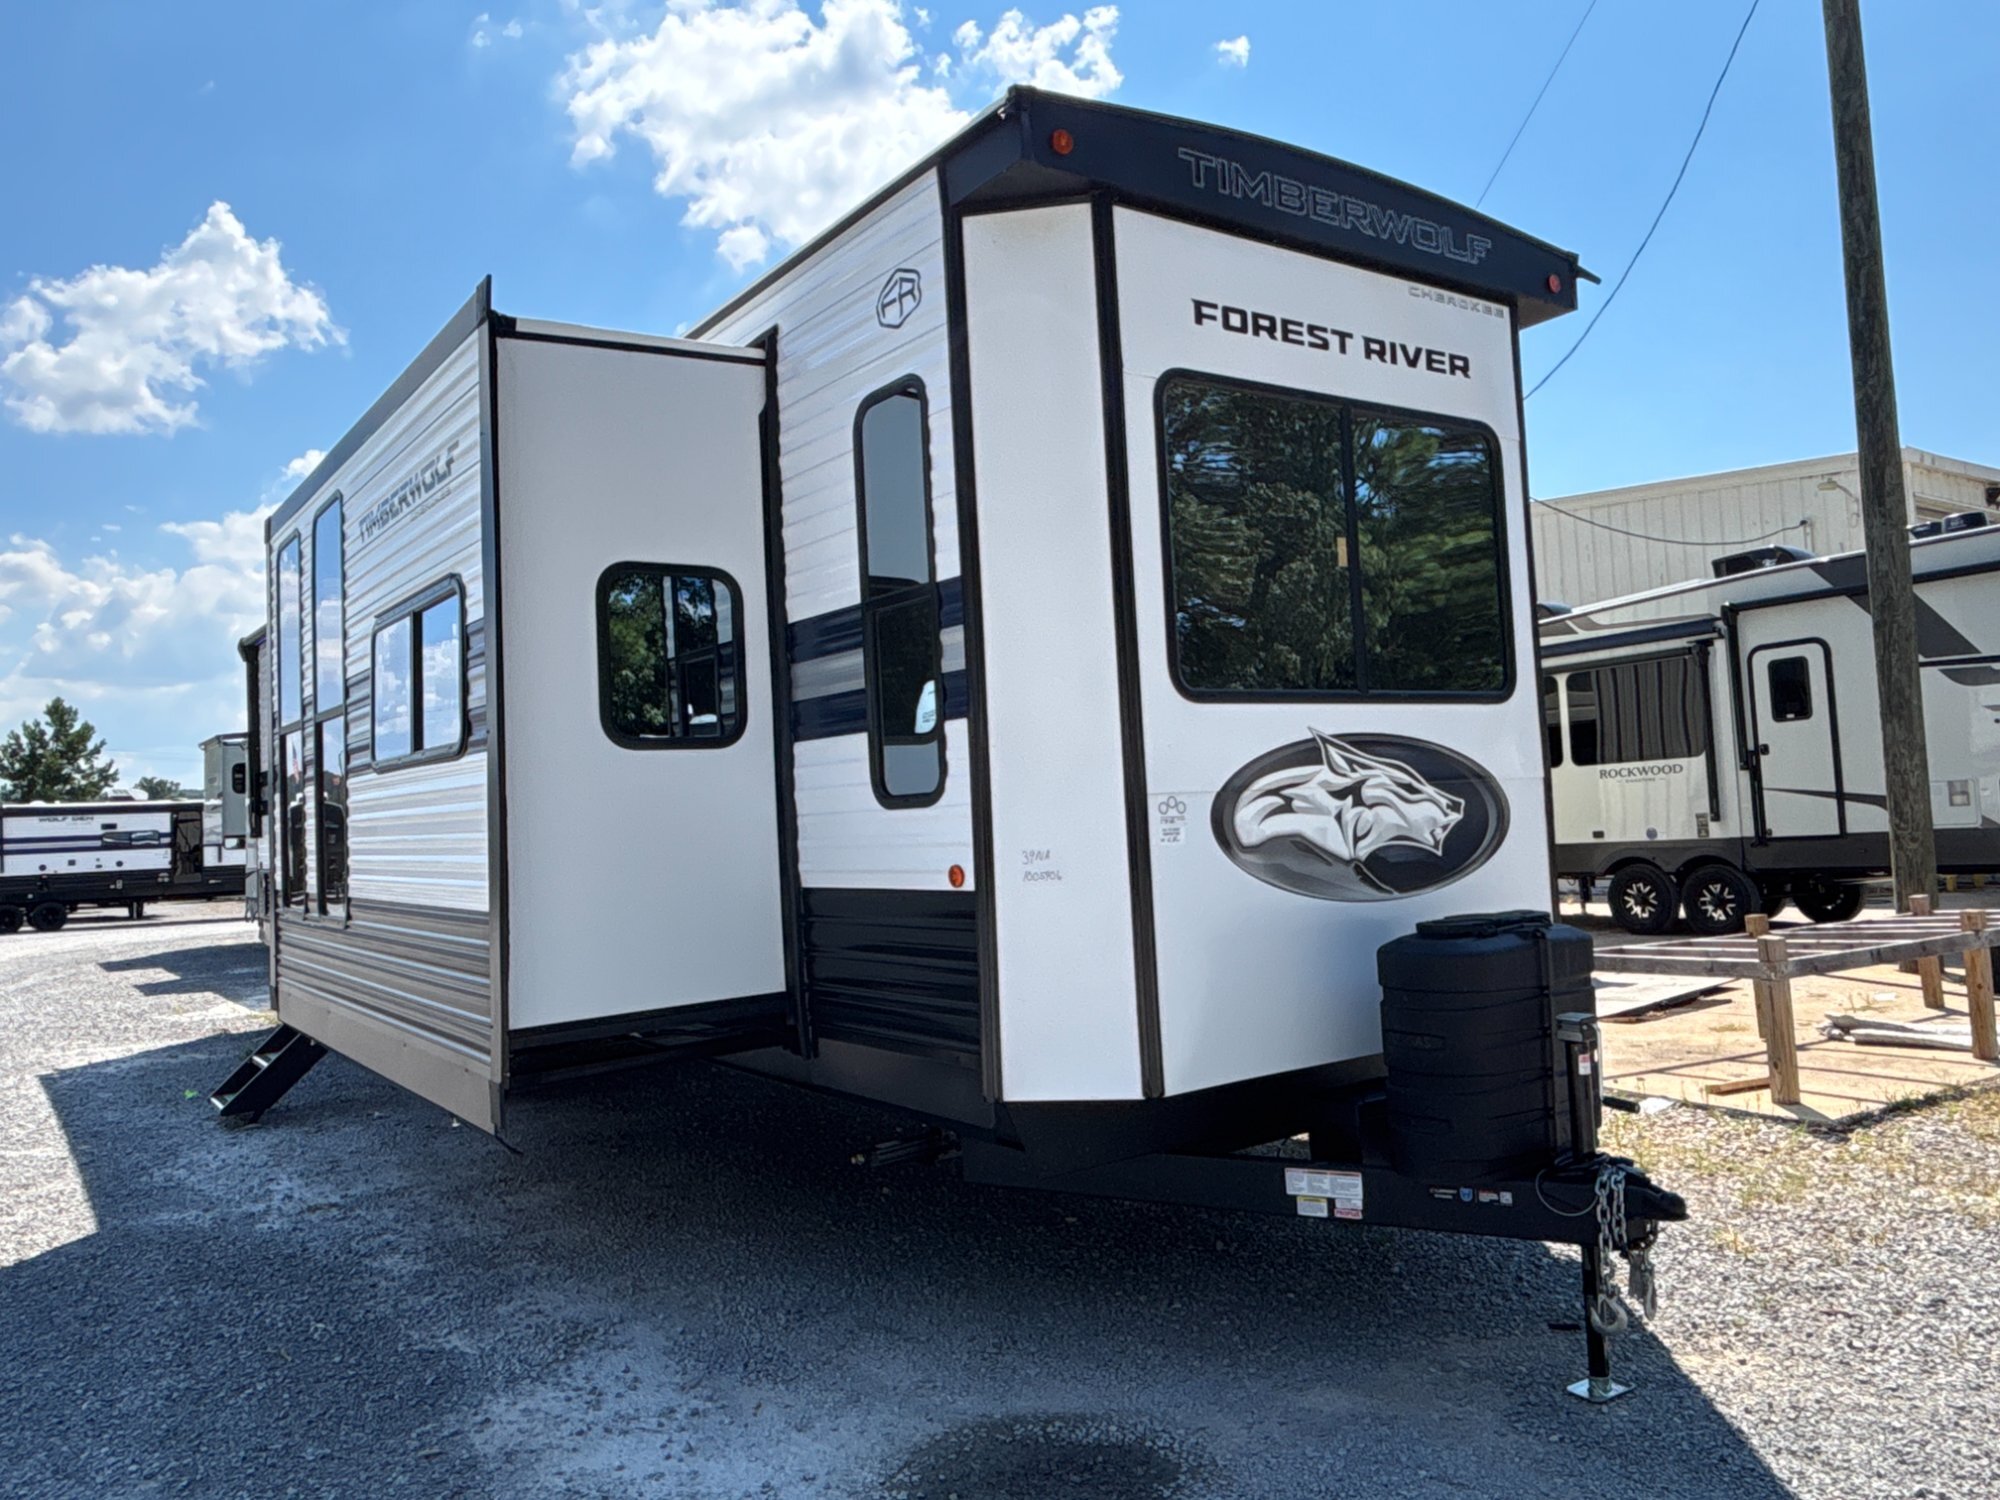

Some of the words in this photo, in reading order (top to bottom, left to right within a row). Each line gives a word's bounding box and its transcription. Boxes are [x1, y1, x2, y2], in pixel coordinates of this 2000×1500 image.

[1178, 146, 1492, 264] TIMBERWOLF
[1191, 297, 1354, 355] FOREST
[1361, 334, 1472, 379] RIVER
[1408, 285, 1505, 319] CHEROKEE
[359, 439, 460, 544] TIMBERWOLF
[1598, 763, 1684, 780] ROCKWOOD
